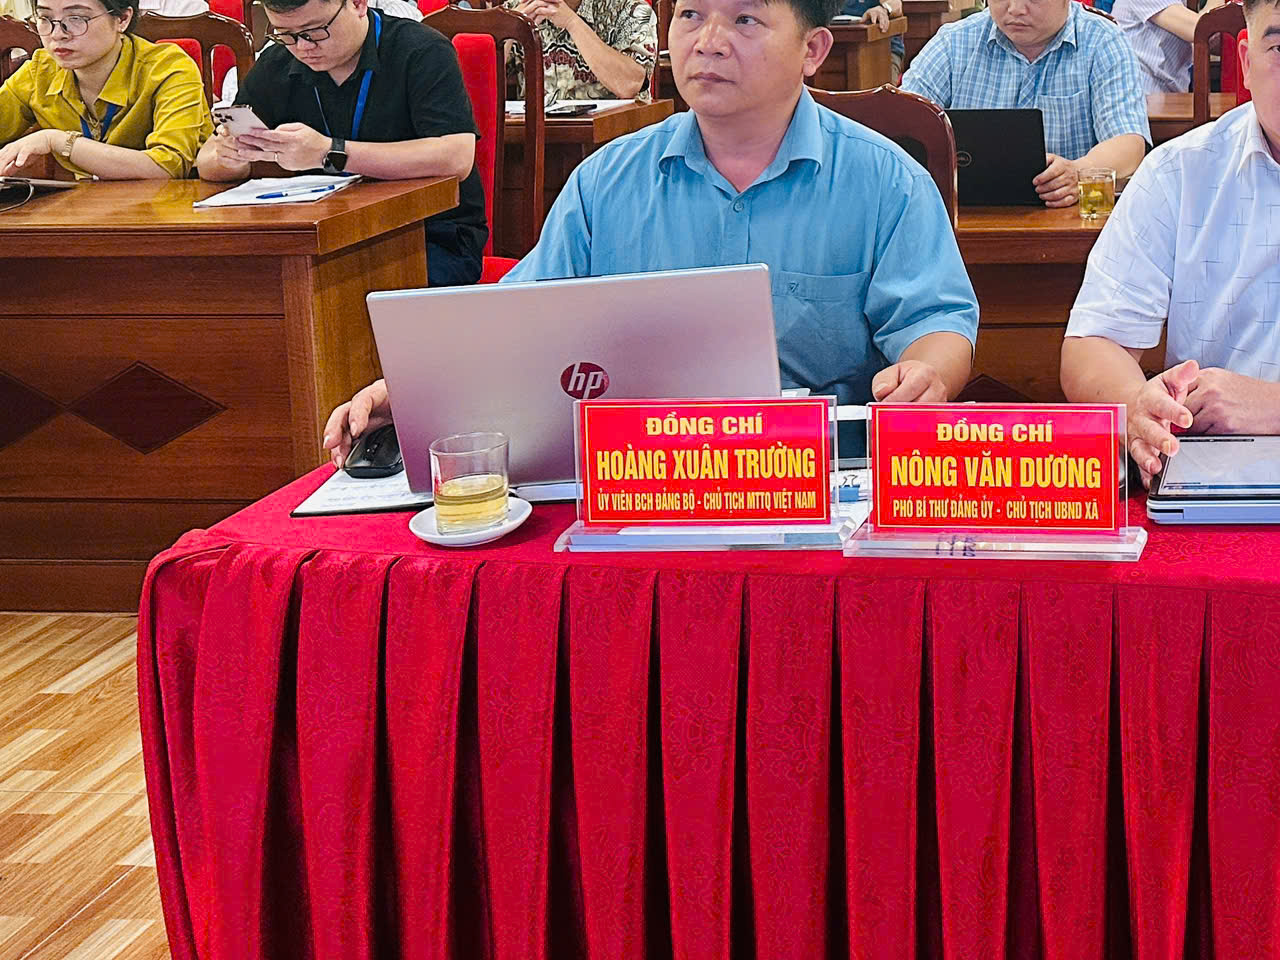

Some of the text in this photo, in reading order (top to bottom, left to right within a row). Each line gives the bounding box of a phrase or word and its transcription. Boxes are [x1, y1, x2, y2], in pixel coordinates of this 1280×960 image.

[567, 361, 604, 400] hp
[646, 411, 763, 436] ĐỒNG CHÍ
[936, 417, 1053, 442] ĐỒNG CHÍ
[596, 441, 816, 480] HOÀNG XUÂN TRƯỜNG
[891, 449, 1101, 489] NÔNG VĂN DƯƠNG
[597, 488, 610, 511] ỦY
[612, 489, 633, 511] VIÊN
[635, 492, 653, 511] BCH
[655, 486, 681, 511] ĐẢNG
[683, 488, 695, 515] BỘ
[703, 486, 722, 510] CHỦ
[724, 491, 745, 514] TỊCH
[746, 491, 771, 512] MTTQ
[773, 488, 793, 513] VIỆT
[795, 491, 817, 509] NAM
[893, 495, 914, 518] PHÓ
[916, 495, 927, 518] BÍ
[929, 498, 949, 518] THƯ
[950, 493, 979, 519] ĐẢNG
[980, 494, 994, 519] ỦY
[1006, 495, 1027, 519] CHỦ
[1029, 500, 1052, 523] TỊCH
[1054, 501, 1082, 519] UBND
[1085, 498, 1099, 520] XÃ
